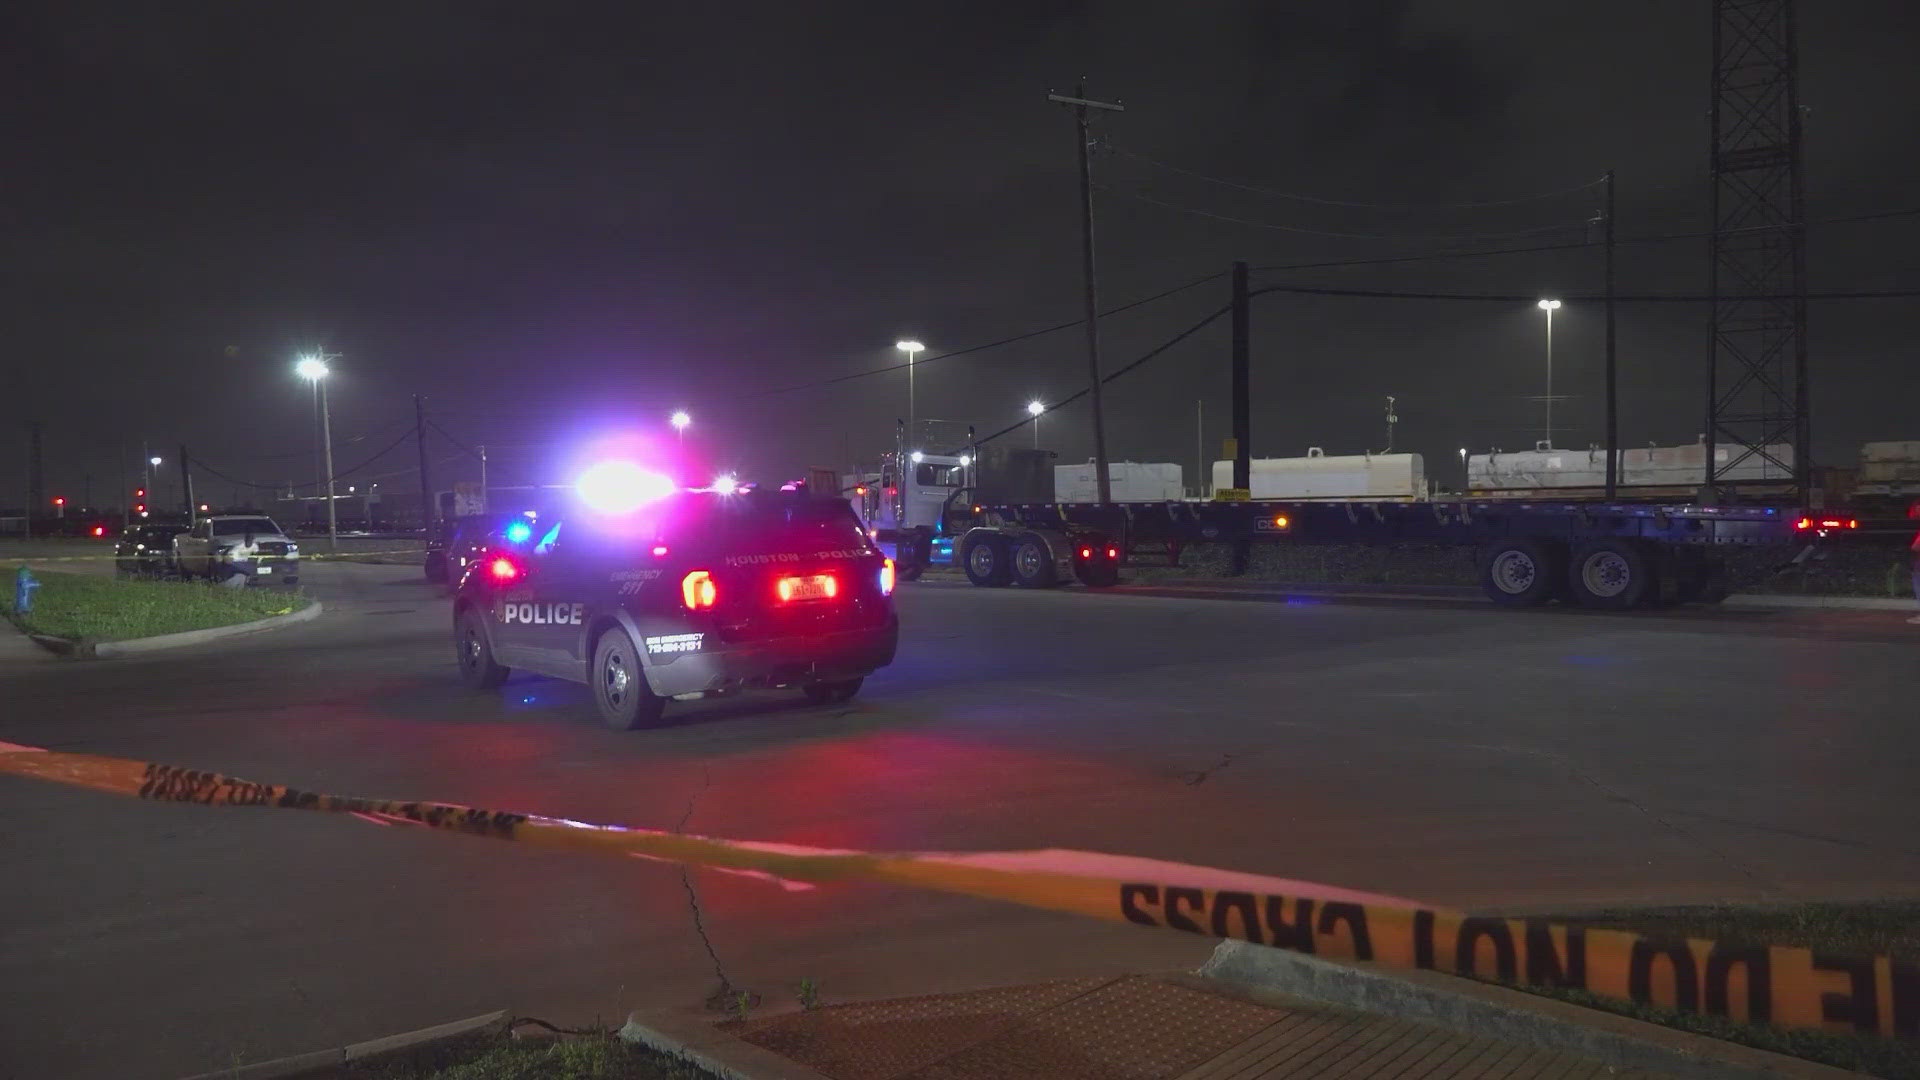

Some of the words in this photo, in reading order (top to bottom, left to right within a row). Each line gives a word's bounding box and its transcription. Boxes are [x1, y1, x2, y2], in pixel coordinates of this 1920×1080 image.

[726, 552, 799, 566] HOUSTON
[818, 549, 876, 560] POLICE
[618, 580, 645, 595] 911
[505, 603, 584, 625] POLICE
